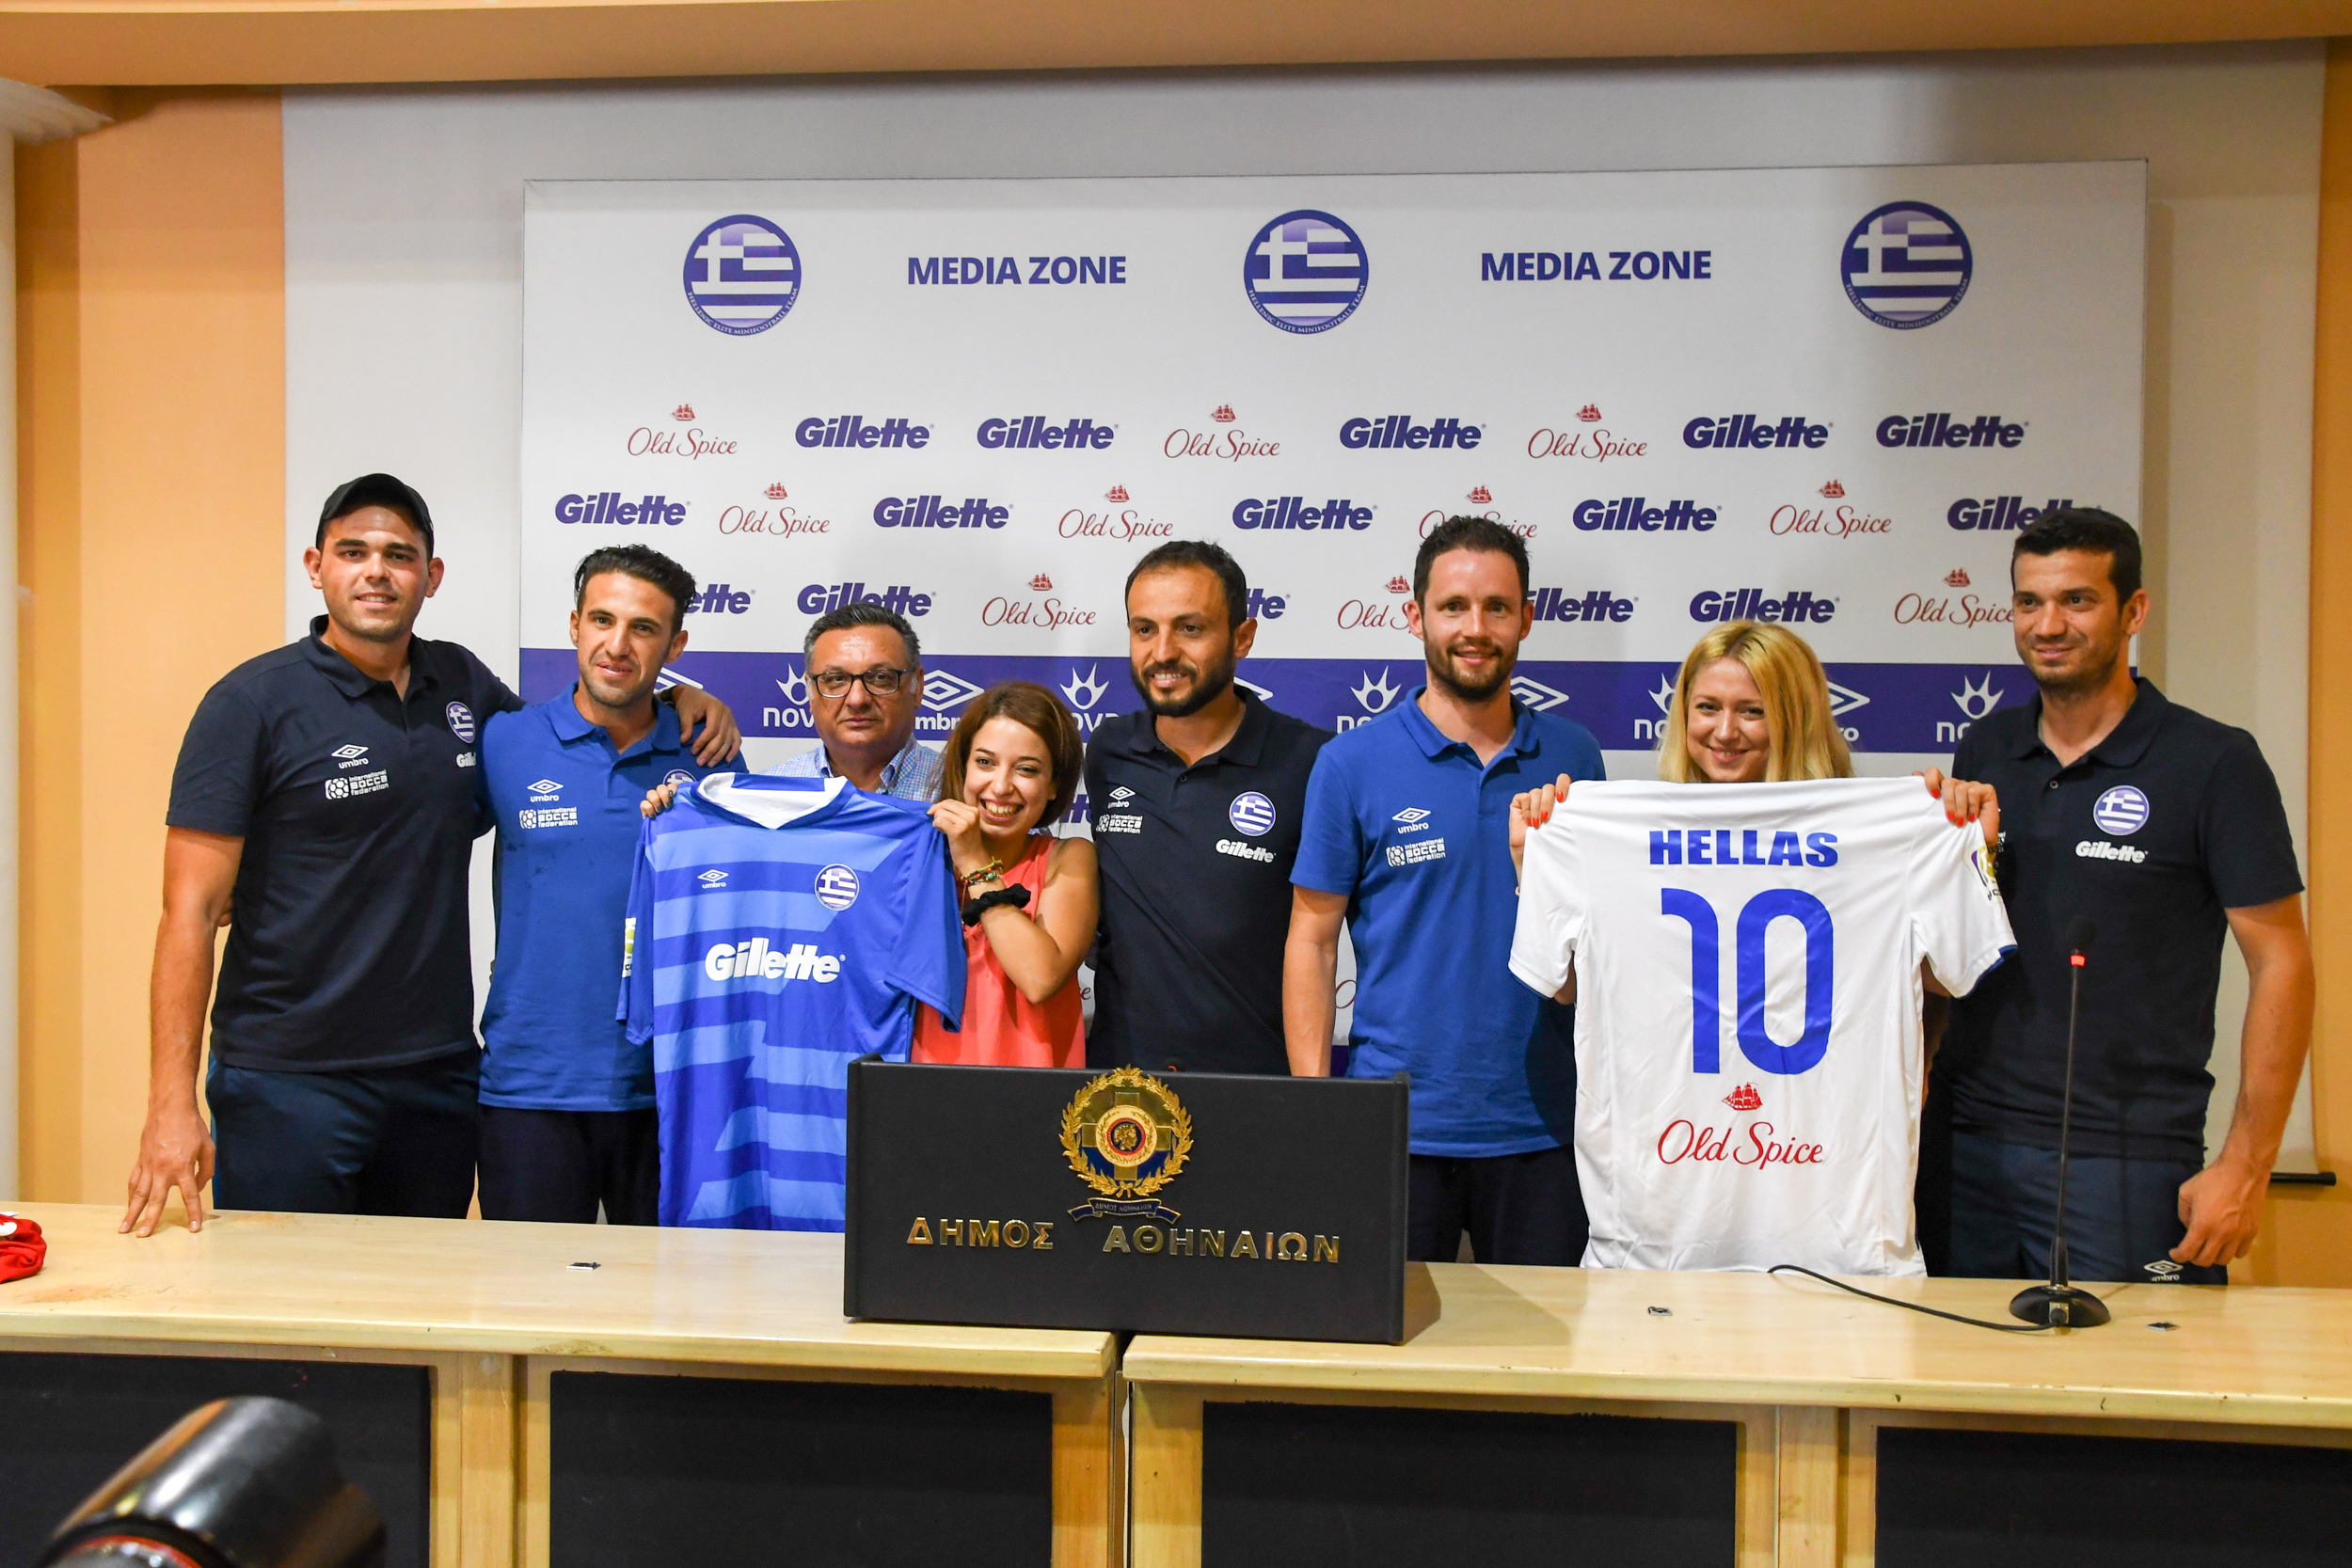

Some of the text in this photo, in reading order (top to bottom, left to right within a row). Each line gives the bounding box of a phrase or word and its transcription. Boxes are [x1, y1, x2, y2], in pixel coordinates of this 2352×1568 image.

[909, 256, 1126, 285] MEDIA ZONE
[1481, 251, 1711, 281] MEDIA ZONE
[628, 427, 738, 460] Old Spice
[795, 415, 930, 449] Gillette
[977, 416, 1114, 450] Gillette
[1164, 428, 1280, 462] Old Spice
[1340, 415, 1482, 450] Gillette
[1528, 428, 1648, 463] Old Spice
[1683, 415, 1828, 449] Gillette
[1876, 413, 2024, 449] Gillette
[555, 492, 686, 525] Gillette
[720, 505, 831, 539] Old Spice
[873, 495, 1009, 529] Gillette
[1232, 497, 1374, 531] Gillette
[1572, 498, 1717, 531] Gillette
[1770, 504, 1892, 539] Old Spice
[1058, 509, 1173, 543] Old Spice
[981, 596, 1097, 631] Old Spice
[1337, 599, 1387, 629] Old
[1689, 588, 1835, 623] Gillette
[1895, 593, 1947, 625] Old
[763, 707, 815, 728] nov
[914, 712, 961, 731] mbr
[338, 757, 369, 769] umbro
[530, 794, 560, 803] umbro
[1397, 821, 1429, 834] umbro
[1215, 838, 1275, 863] Gillette
[1649, 830, 1838, 867] HELLAS
[2074, 840, 2146, 864] Gillette
[705, 937, 841, 984] Gillette
[1661, 887, 1834, 1075] 10
[1658, 1119, 1823, 1170] Old Spice
[906, 1216, 1340, 1264] ΔΗΜΟΣ ΑΘΗΝΑΙΩΝ
